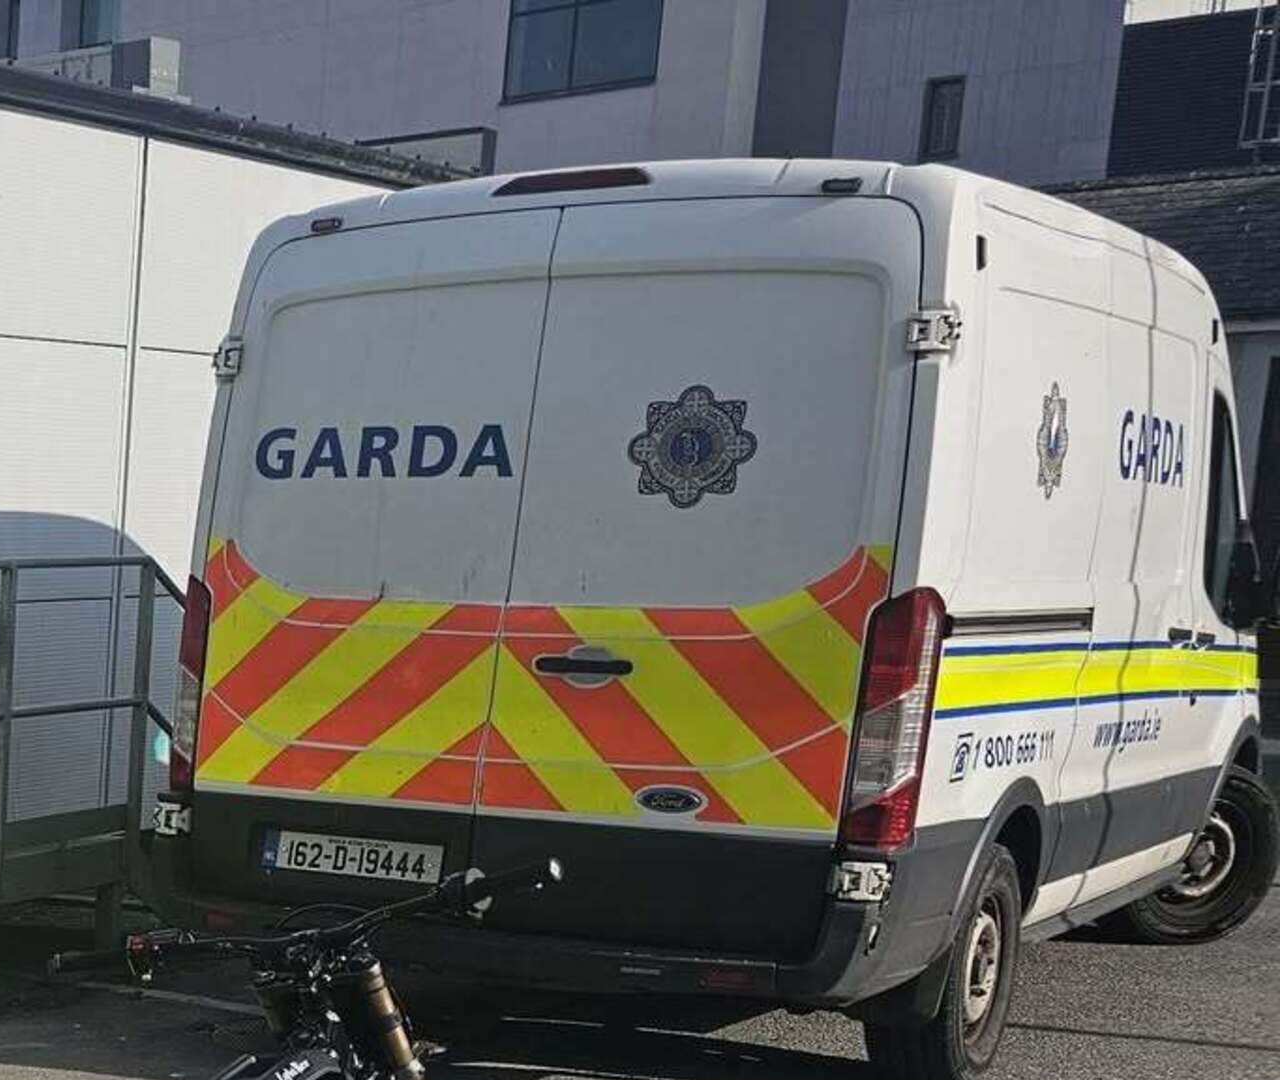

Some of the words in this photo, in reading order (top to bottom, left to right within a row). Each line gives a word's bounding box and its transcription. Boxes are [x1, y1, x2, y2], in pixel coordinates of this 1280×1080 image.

[255, 424, 514, 480] GARDA
[1120, 409, 1184, 489] GARDA
[984, 734, 1013, 768] 800
[1016, 731, 1037, 763] 666
[1093, 709, 1161, 753] www.garda.ie
[287, 839, 426, 880] 162-D-19444
